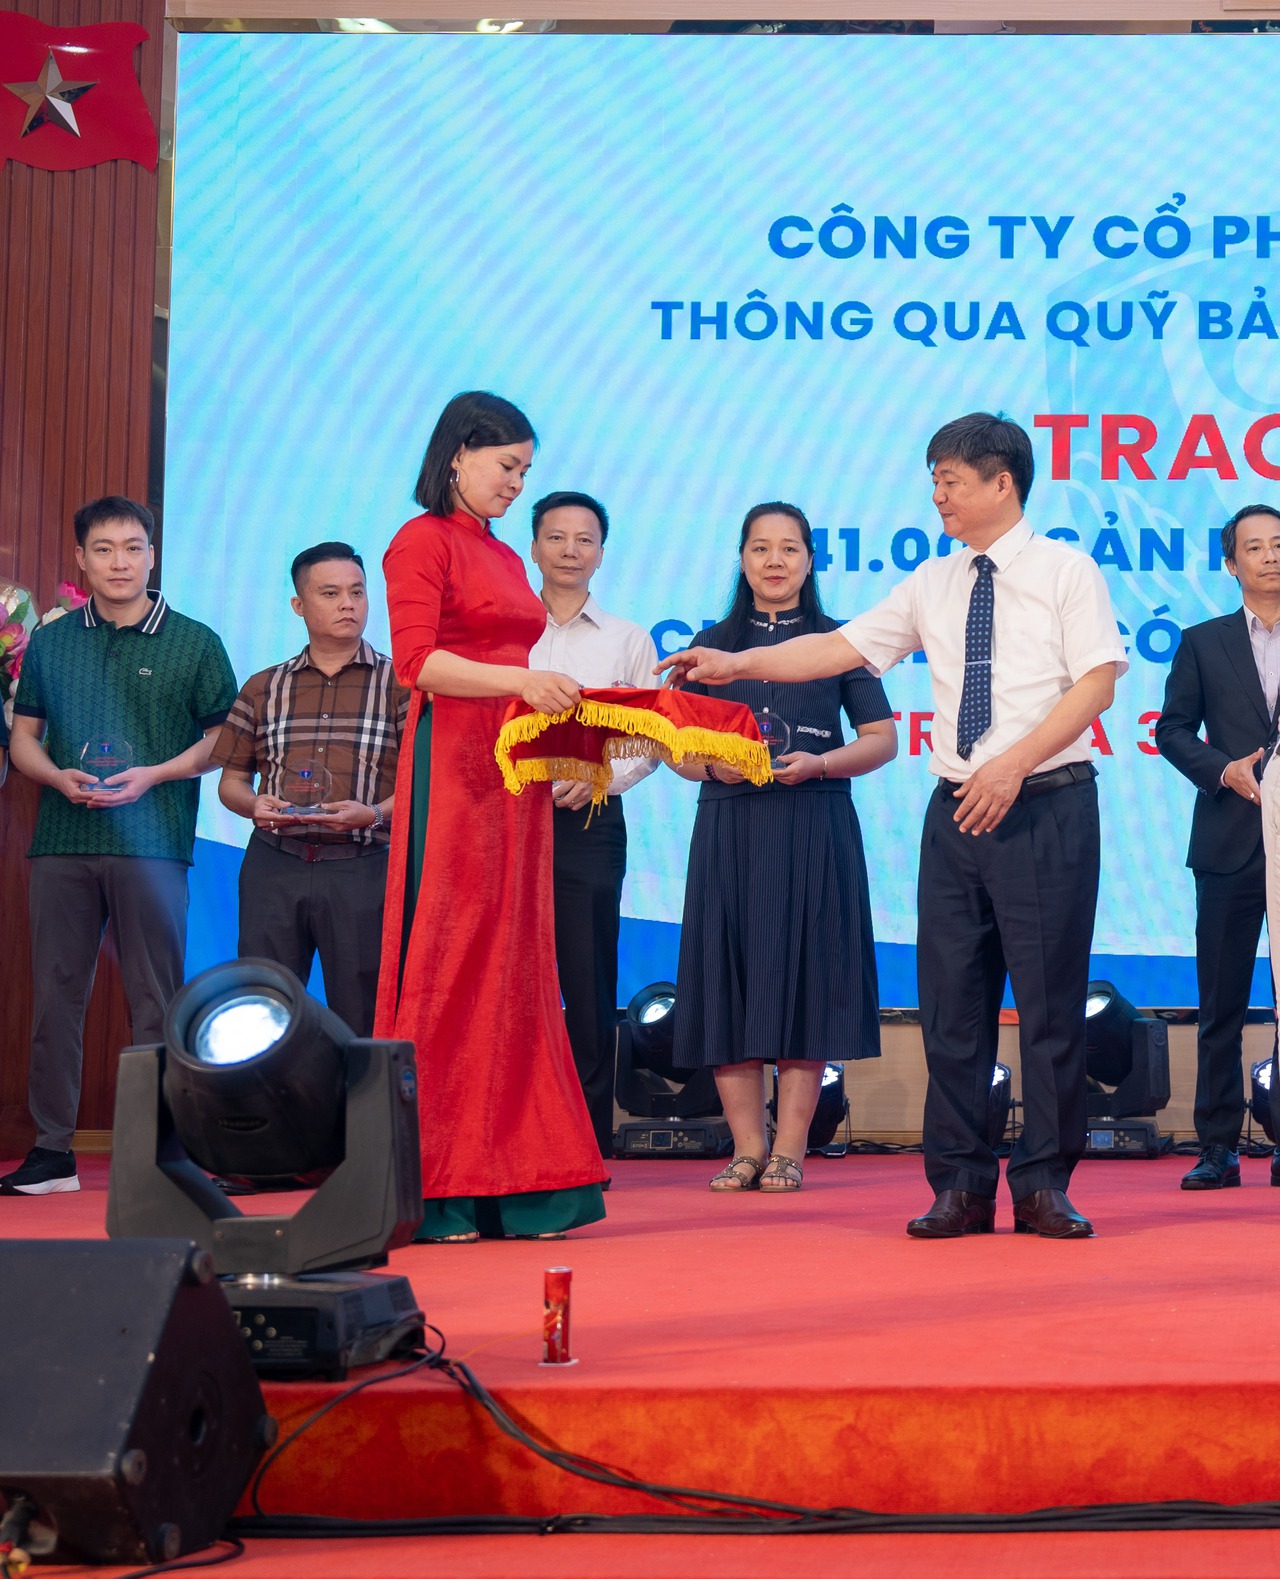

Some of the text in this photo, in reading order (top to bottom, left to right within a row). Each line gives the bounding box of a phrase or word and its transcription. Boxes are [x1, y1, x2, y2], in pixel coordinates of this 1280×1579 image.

[768, 202, 970, 260] CÔNG
[988, 215, 1074, 259] TY
[1092, 192, 1191, 260] CỔ
[651, 288, 873, 341] THÔNG
[893, 301, 1026, 347] QUA
[1046, 290, 1177, 347] QUỸ
